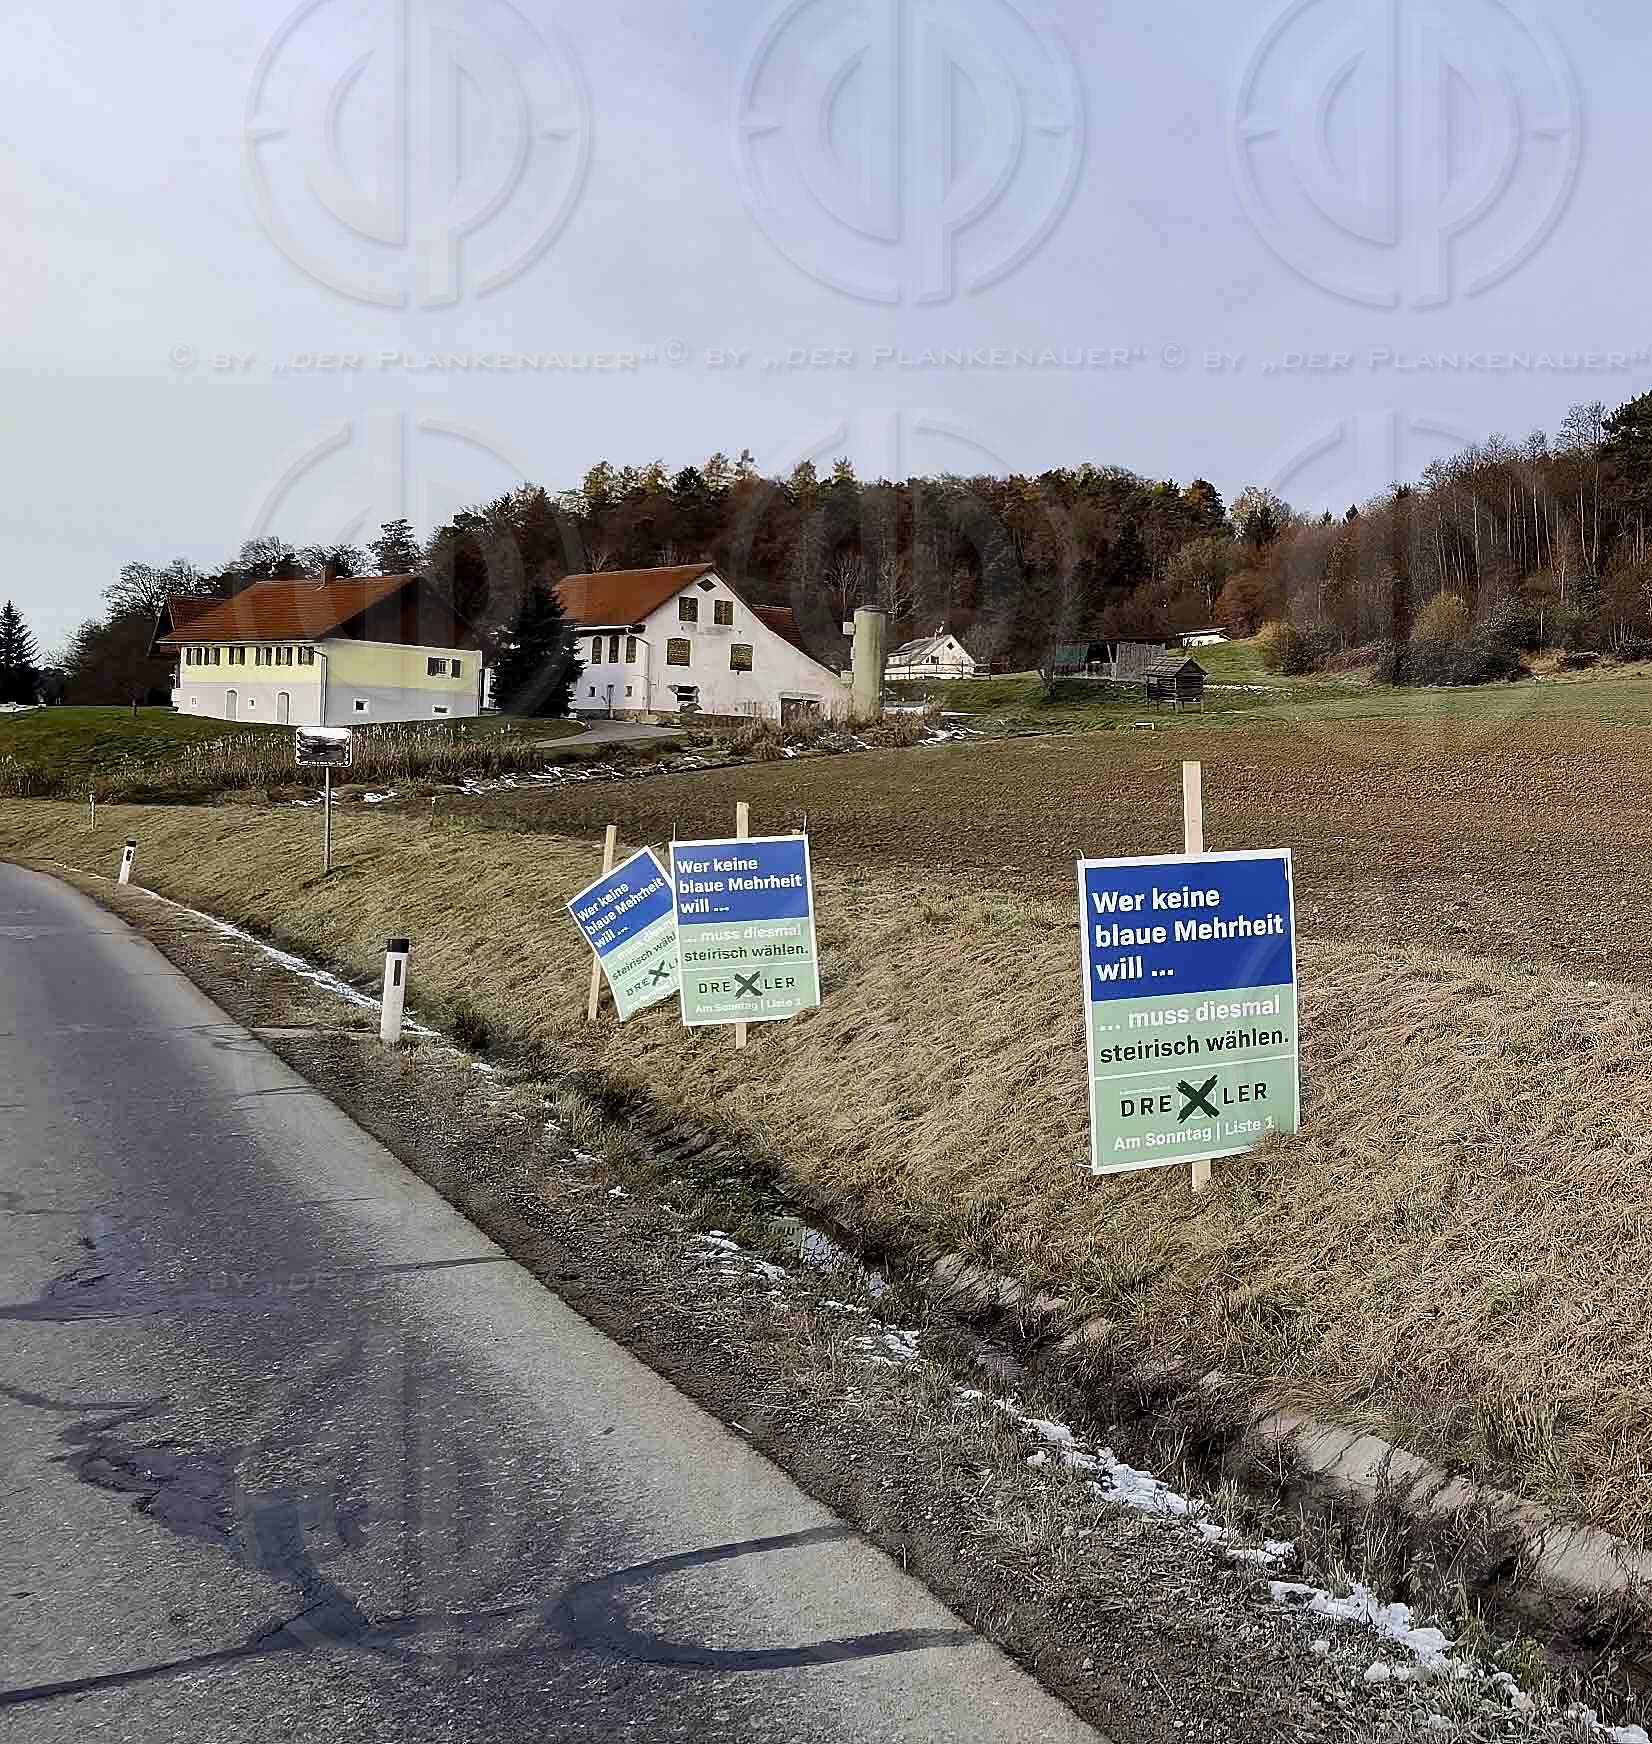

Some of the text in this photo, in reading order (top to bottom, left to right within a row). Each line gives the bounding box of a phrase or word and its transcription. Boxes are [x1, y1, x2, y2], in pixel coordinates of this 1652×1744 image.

[677, 857, 758, 873] Wer keine
[679, 873, 802, 893] blaue Mehrheit
[577, 883, 629, 921] Wer keine
[585, 877, 664, 935] blaue Mehrheit
[680, 898, 709, 913] will
[1092, 886, 1221, 914] Wer keine
[594, 928, 616, 948] will
[702, 929, 740, 942] muss
[743, 924, 801, 939] diesmal
[1095, 913, 1285, 948] blaue Mehrheit
[684, 943, 809, 961] steirisch wählen.
[1096, 956, 1143, 982] will
[698, 971, 795, 1000] DREXLER
[1128, 1004, 1189, 1029] muss
[1195, 995, 1281, 1022] diesmal
[1100, 1028, 1290, 1064] steirisch wählen.
[1120, 1074, 1268, 1124] DREXLER
[1113, 1136, 1141, 1151] Am
[1145, 1124, 1213, 1147] Sonntag
[1225, 1119, 1261, 1136] Liste
[1264, 1115, 1275, 1129] 1
